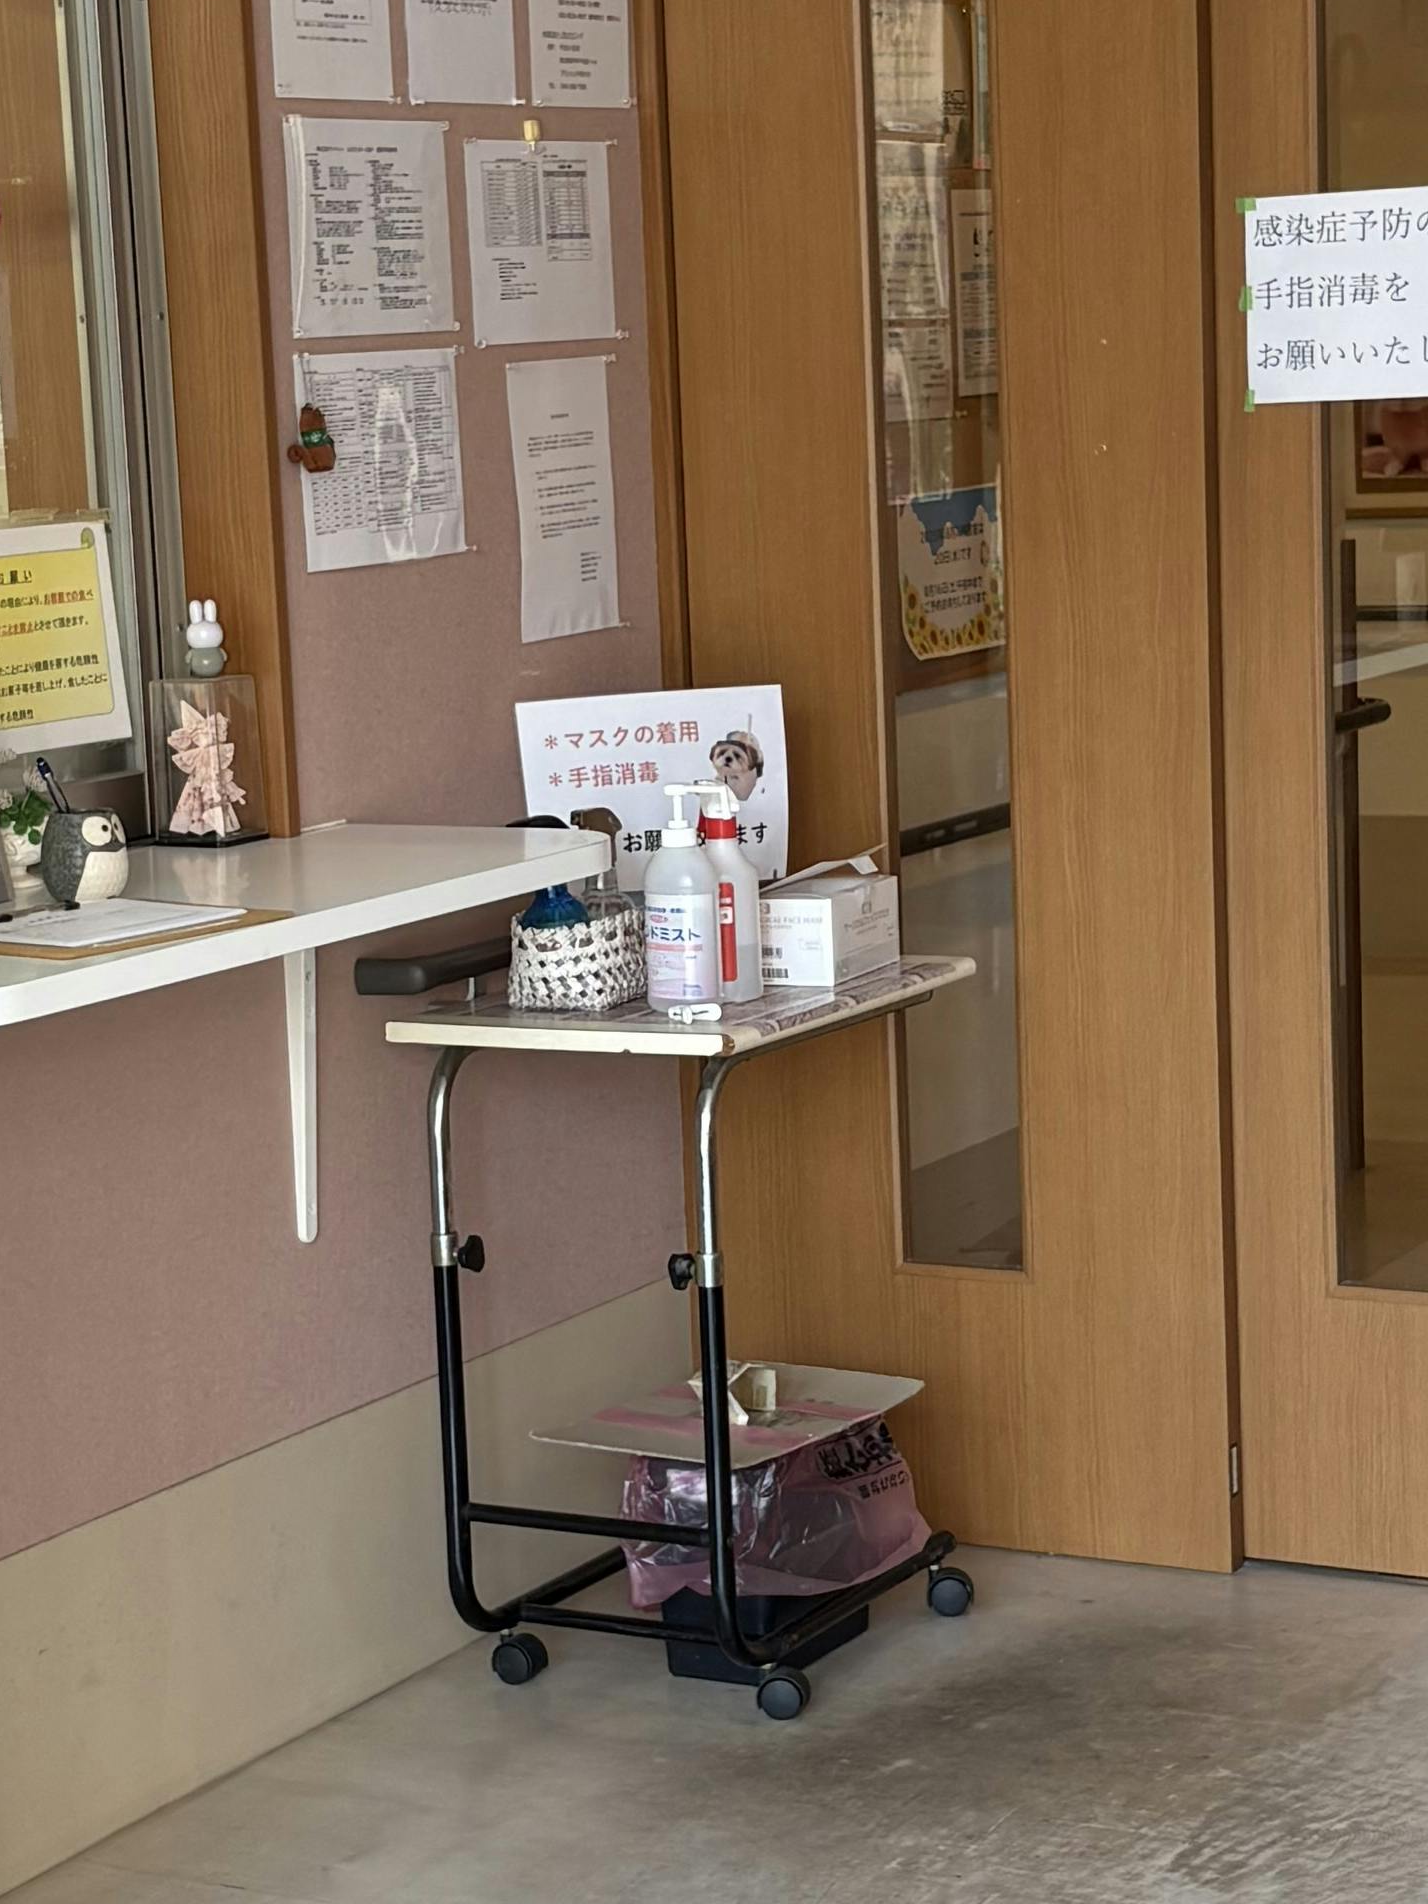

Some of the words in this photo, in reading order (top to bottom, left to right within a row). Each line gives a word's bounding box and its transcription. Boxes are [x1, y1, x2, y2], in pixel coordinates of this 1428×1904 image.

[1255, 271, 1410, 310] 手指消毒を
[564, 721, 700, 749] マスクの着用
[568, 761, 660, 789] 手指消毒
